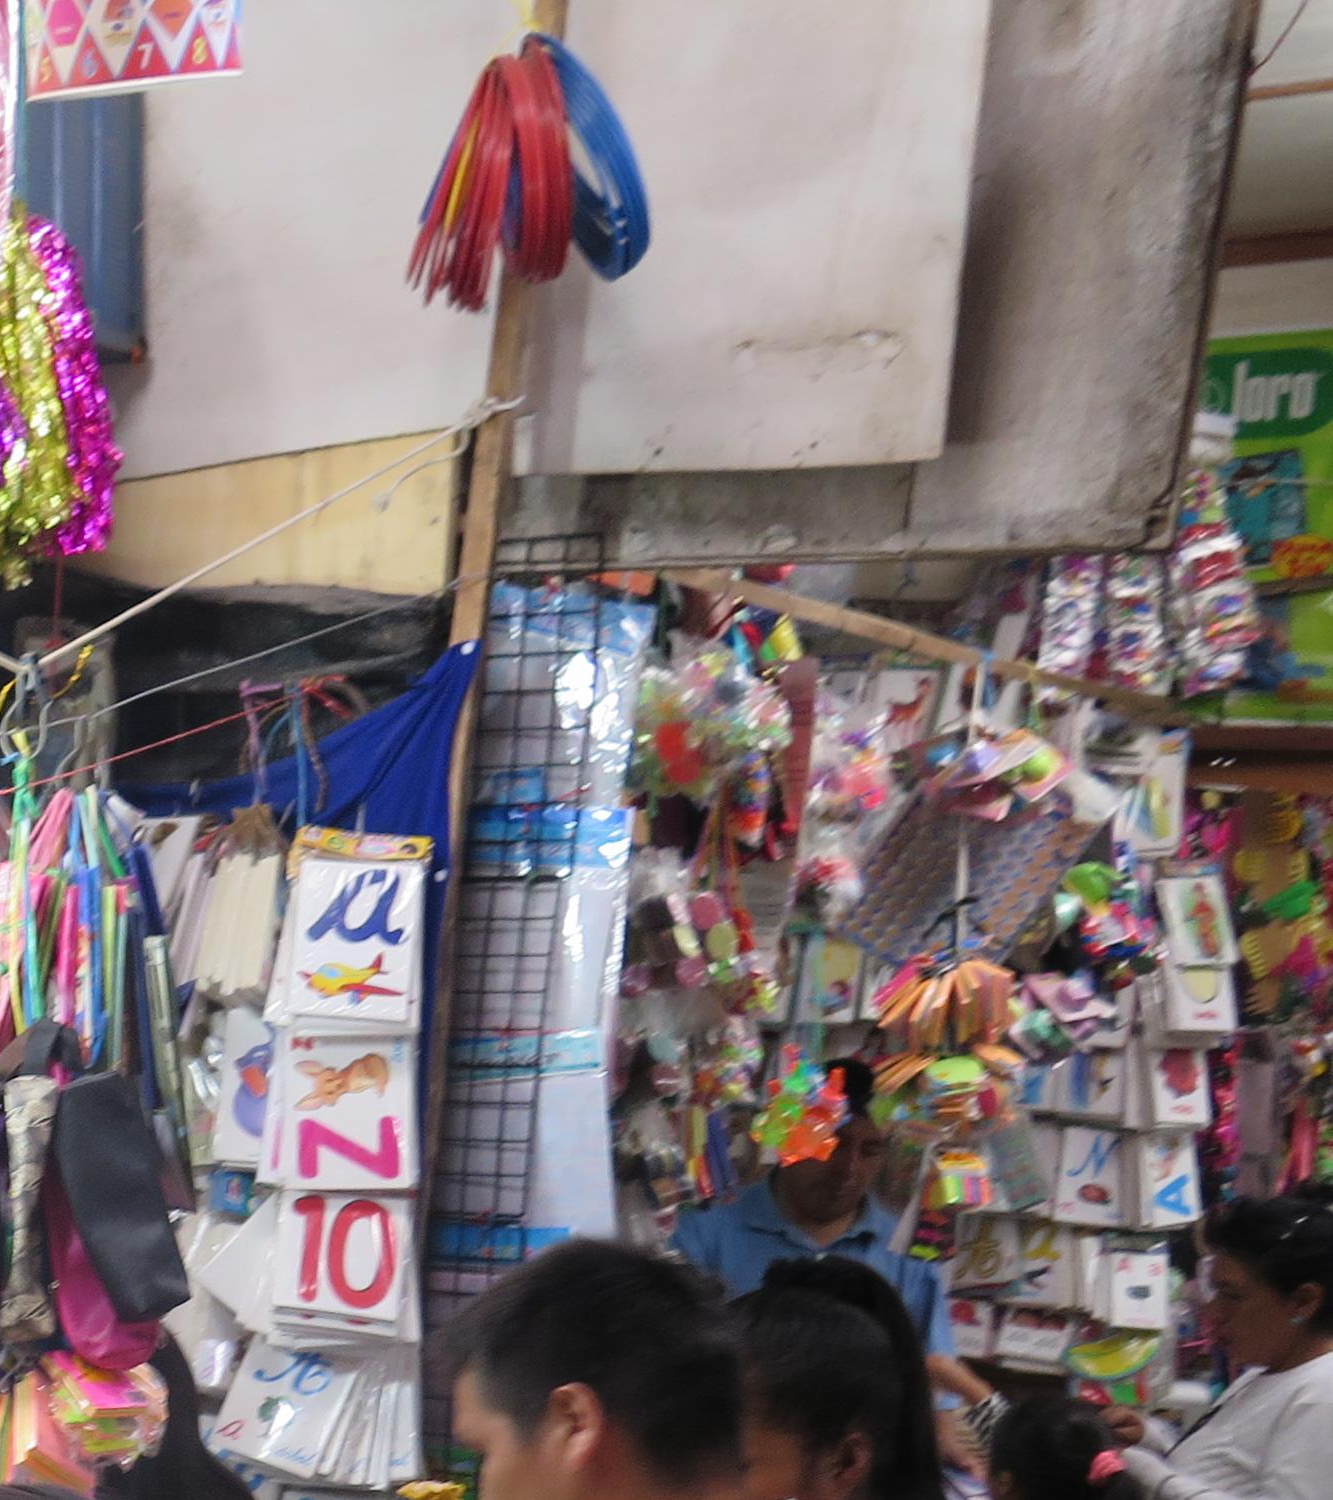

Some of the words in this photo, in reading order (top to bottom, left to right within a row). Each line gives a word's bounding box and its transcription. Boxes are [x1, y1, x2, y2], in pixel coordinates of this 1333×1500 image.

[137, 42, 155, 70] 7
[191, 36, 207, 65] 8
[294, 1195, 396, 1309] 10
